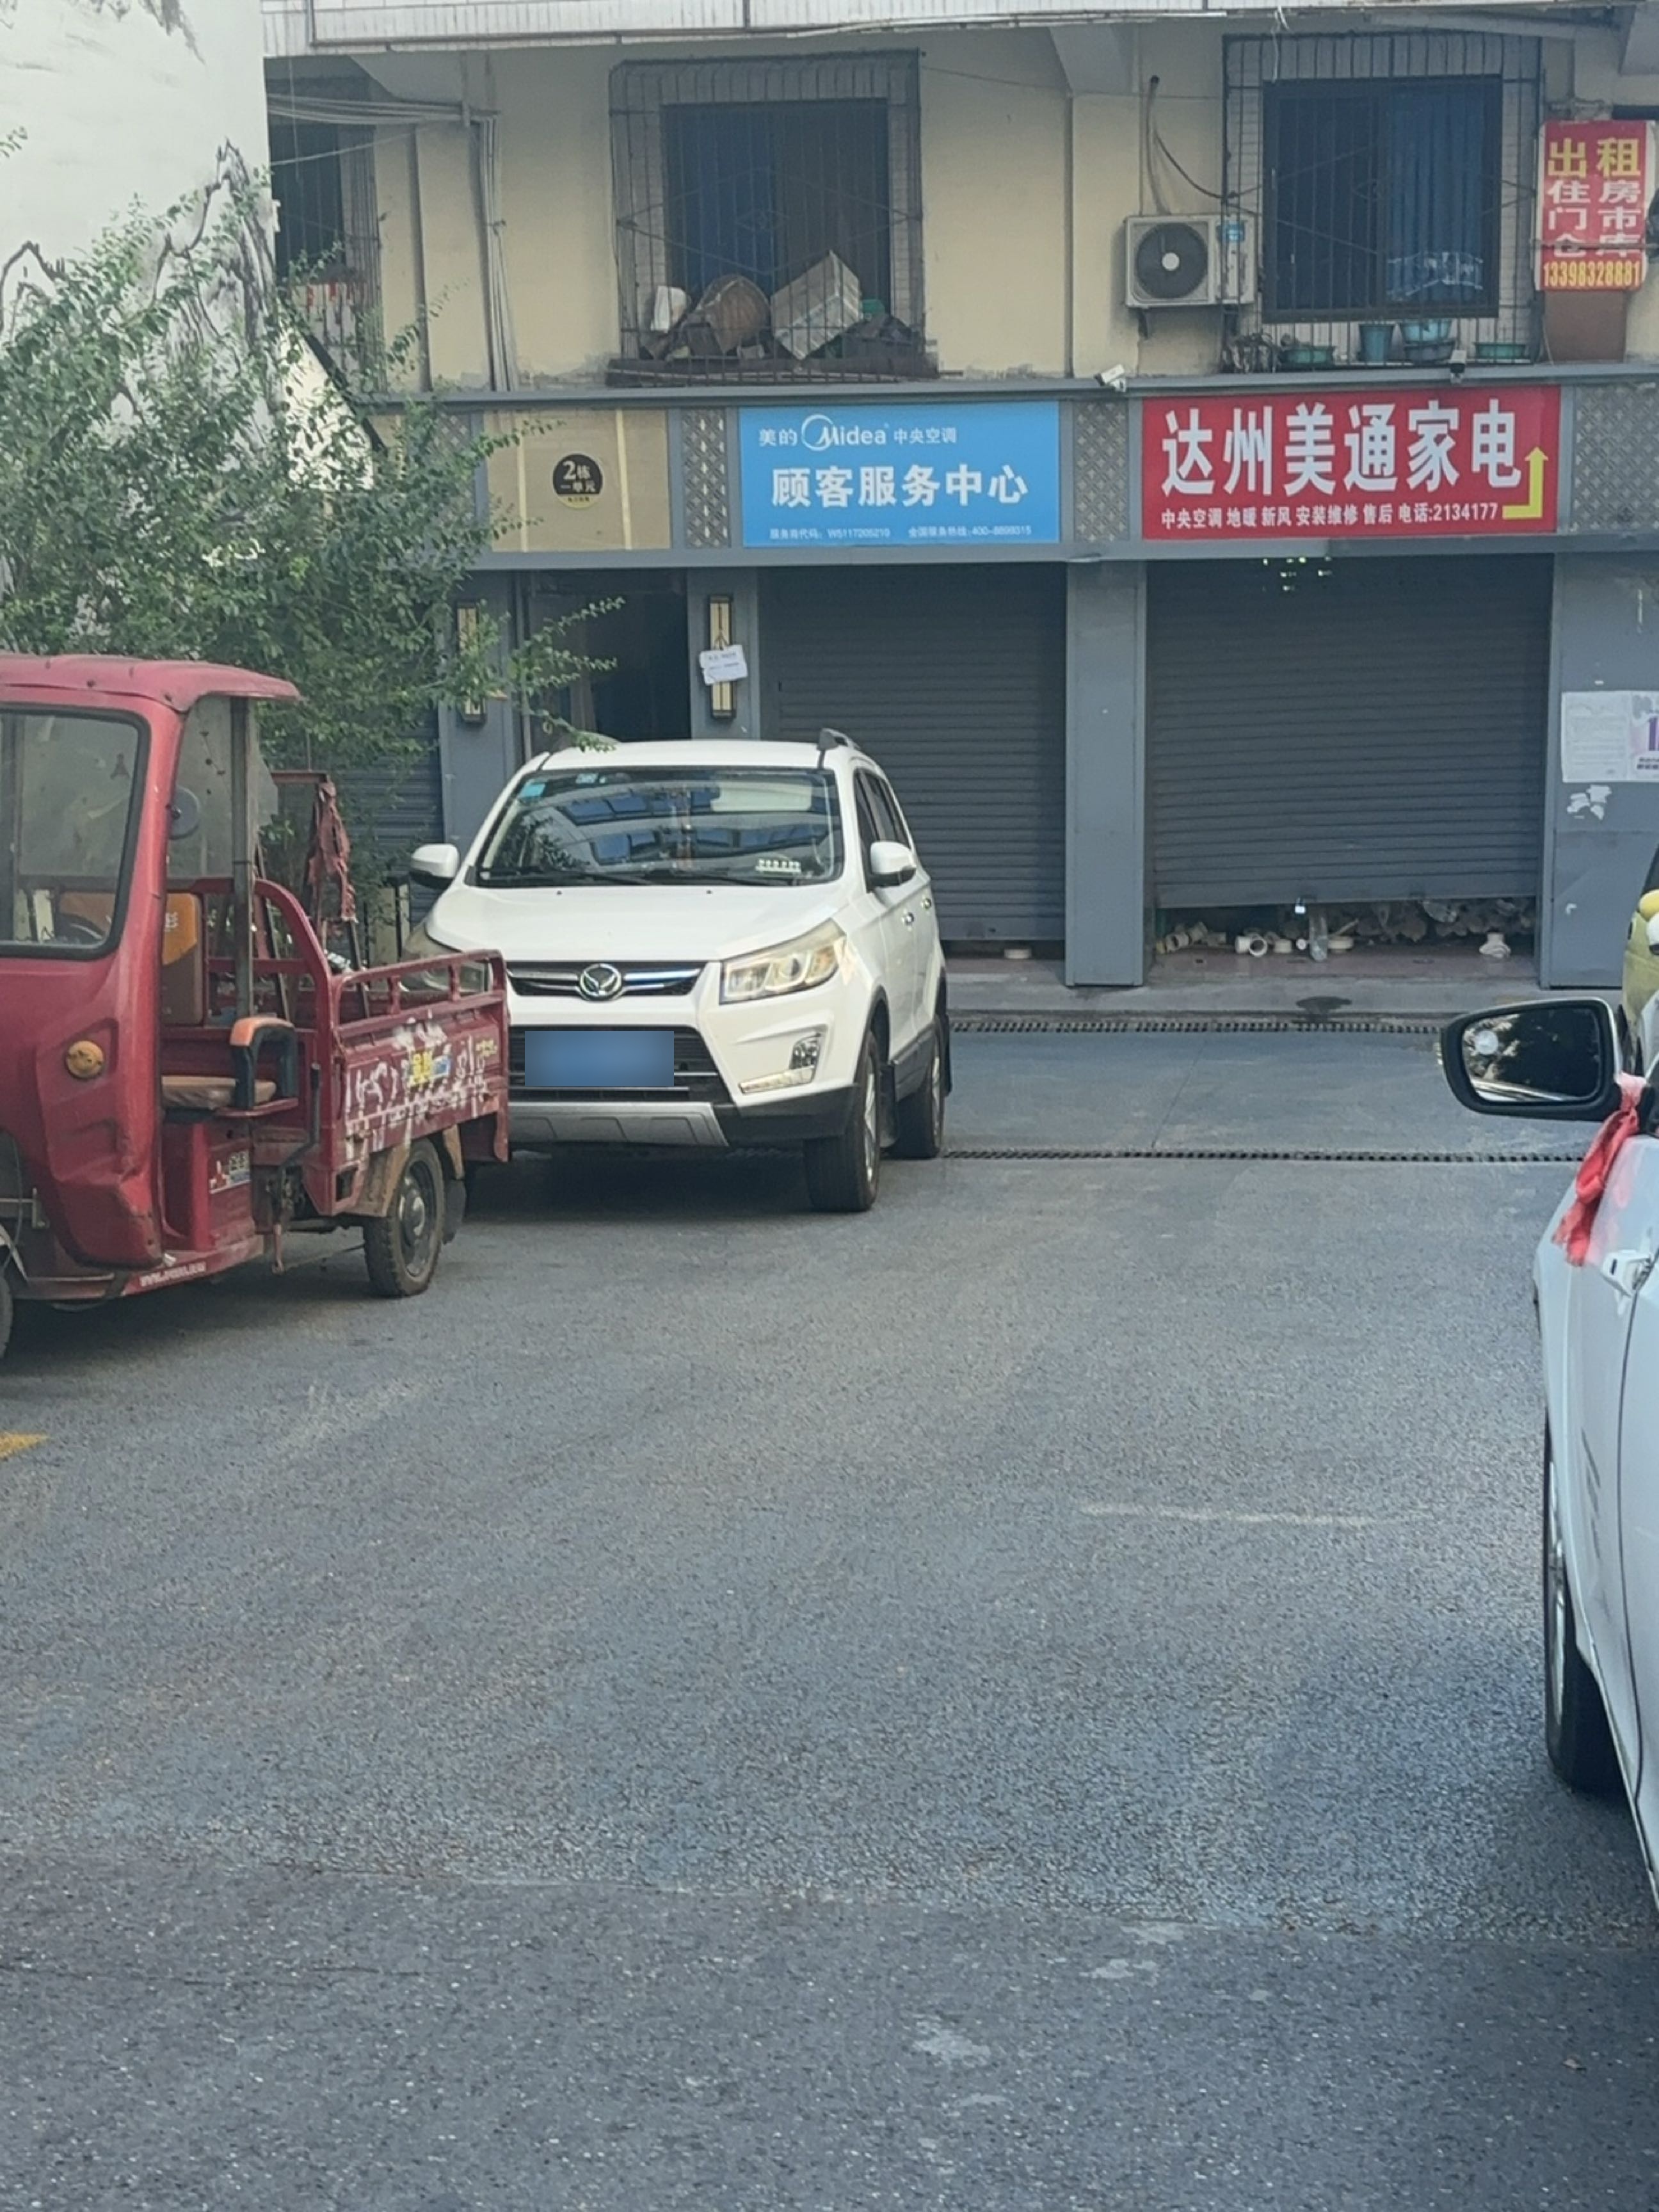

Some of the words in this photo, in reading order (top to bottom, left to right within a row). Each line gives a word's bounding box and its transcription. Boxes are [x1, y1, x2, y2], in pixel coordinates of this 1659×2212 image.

[1547, 137, 1641, 179] 出租
[1547, 180, 1641, 203] 住房
[1548, 207, 1641, 230] 门市
[759, 428, 798, 446] 美的
[808, 419, 888, 449] Midea
[894, 427, 958, 445] 中央空调
[1161, 399, 1521, 495] 达州美通家电
[772, 463, 1028, 508] 顾客服务中心
[1160, 508, 1223, 530] 中央空调
[1226, 506, 1257, 529] 地暖
[1261, 506, 1292, 528] 新风
[1295, 503, 1359, 526] 安装维修
[1363, 503, 1393, 525] 售后
[1398, 501, 1498, 524] 电话:2134177
